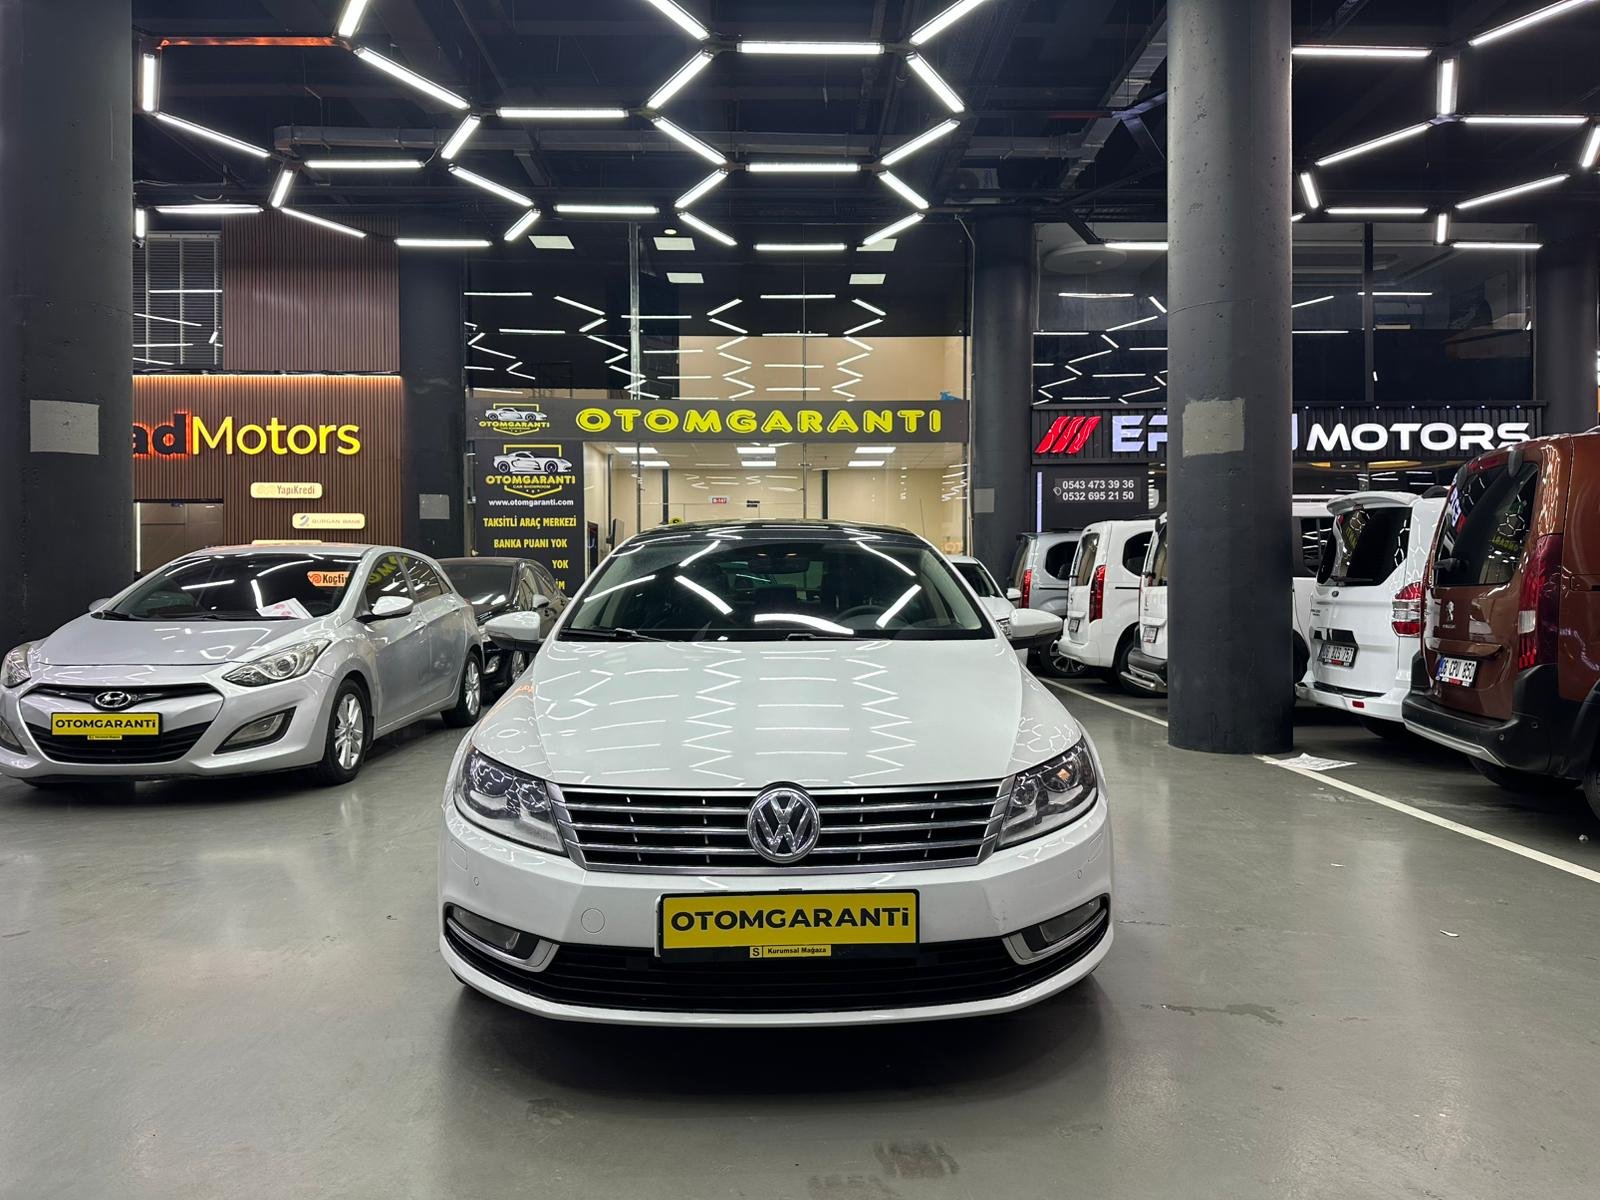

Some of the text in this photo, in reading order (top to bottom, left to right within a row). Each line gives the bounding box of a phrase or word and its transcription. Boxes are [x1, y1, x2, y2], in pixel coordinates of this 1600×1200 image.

[576, 408, 942, 433] OTOMGARANTI
[1306, 423, 1530, 451] MOTORS
[485, 475, 576, 484] OTOMGARANTI
[1062, 480, 1134, 489] 0543 473 39 36
[1062, 491, 1134, 500] 0532 695 21 50
[489, 499, 574, 507] www.otomgaranti.com
[483, 515, 577, 530] TAKSİTLİ ARAÇ MERKEZİ
[494, 539, 568, 548] BANKA PUANI YOK
[552, 559, 569, 569] YOK
[767, 946, 799, 955] Kurumsal
[800, 945, 827, 955] Mağaza
